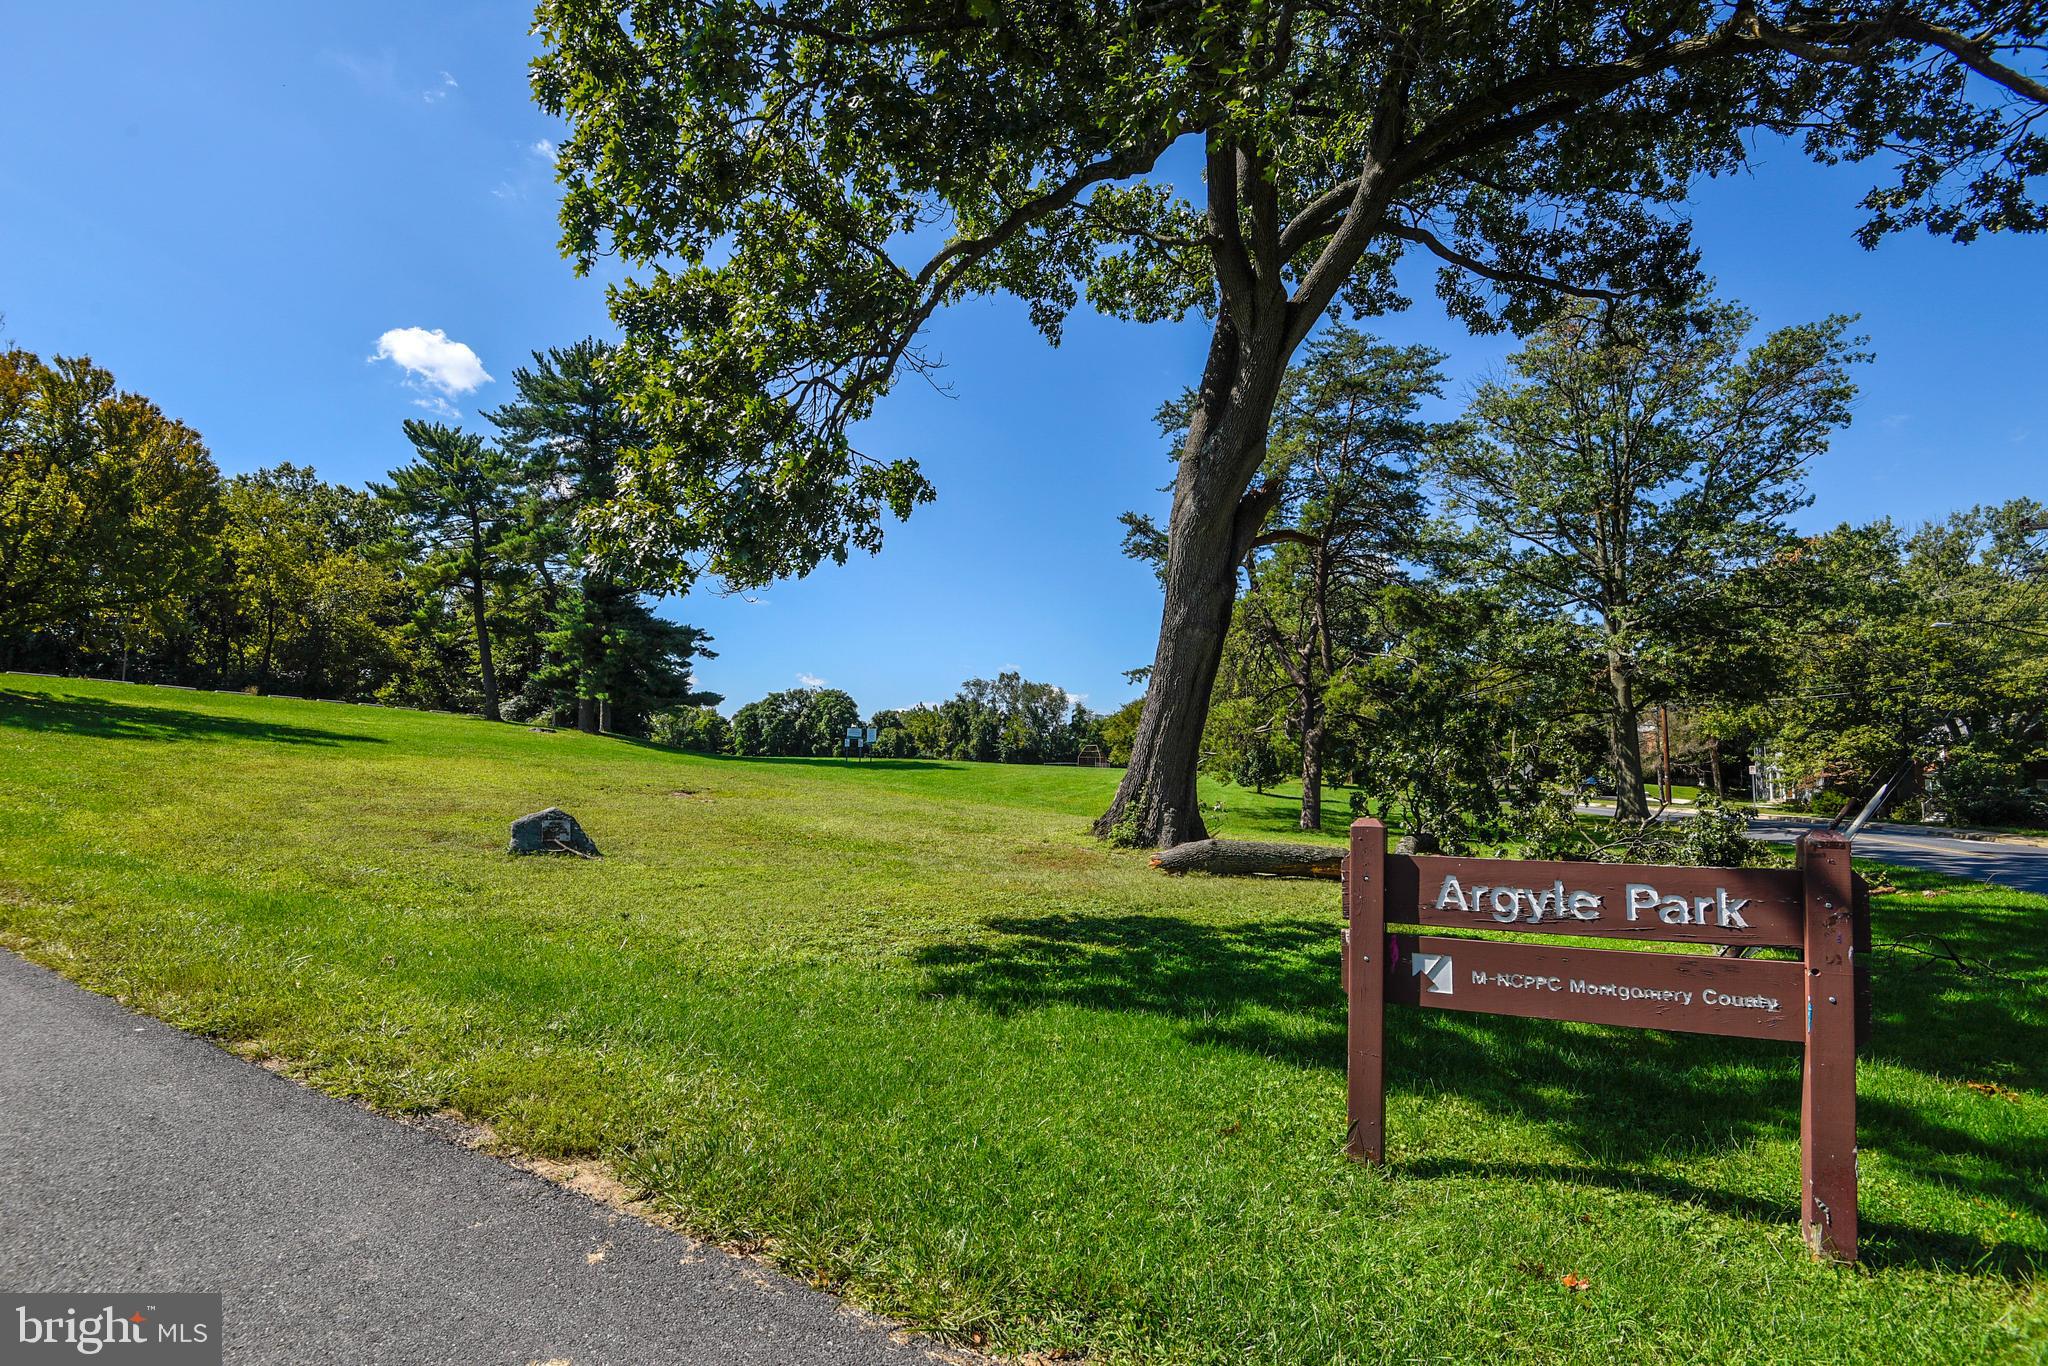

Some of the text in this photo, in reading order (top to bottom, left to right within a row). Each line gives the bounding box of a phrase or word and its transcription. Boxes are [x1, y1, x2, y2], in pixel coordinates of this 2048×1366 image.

[1435, 874, 1752, 929] Argyle Park
[1471, 970, 1781, 1013] M-NCPPC Montgomery County
